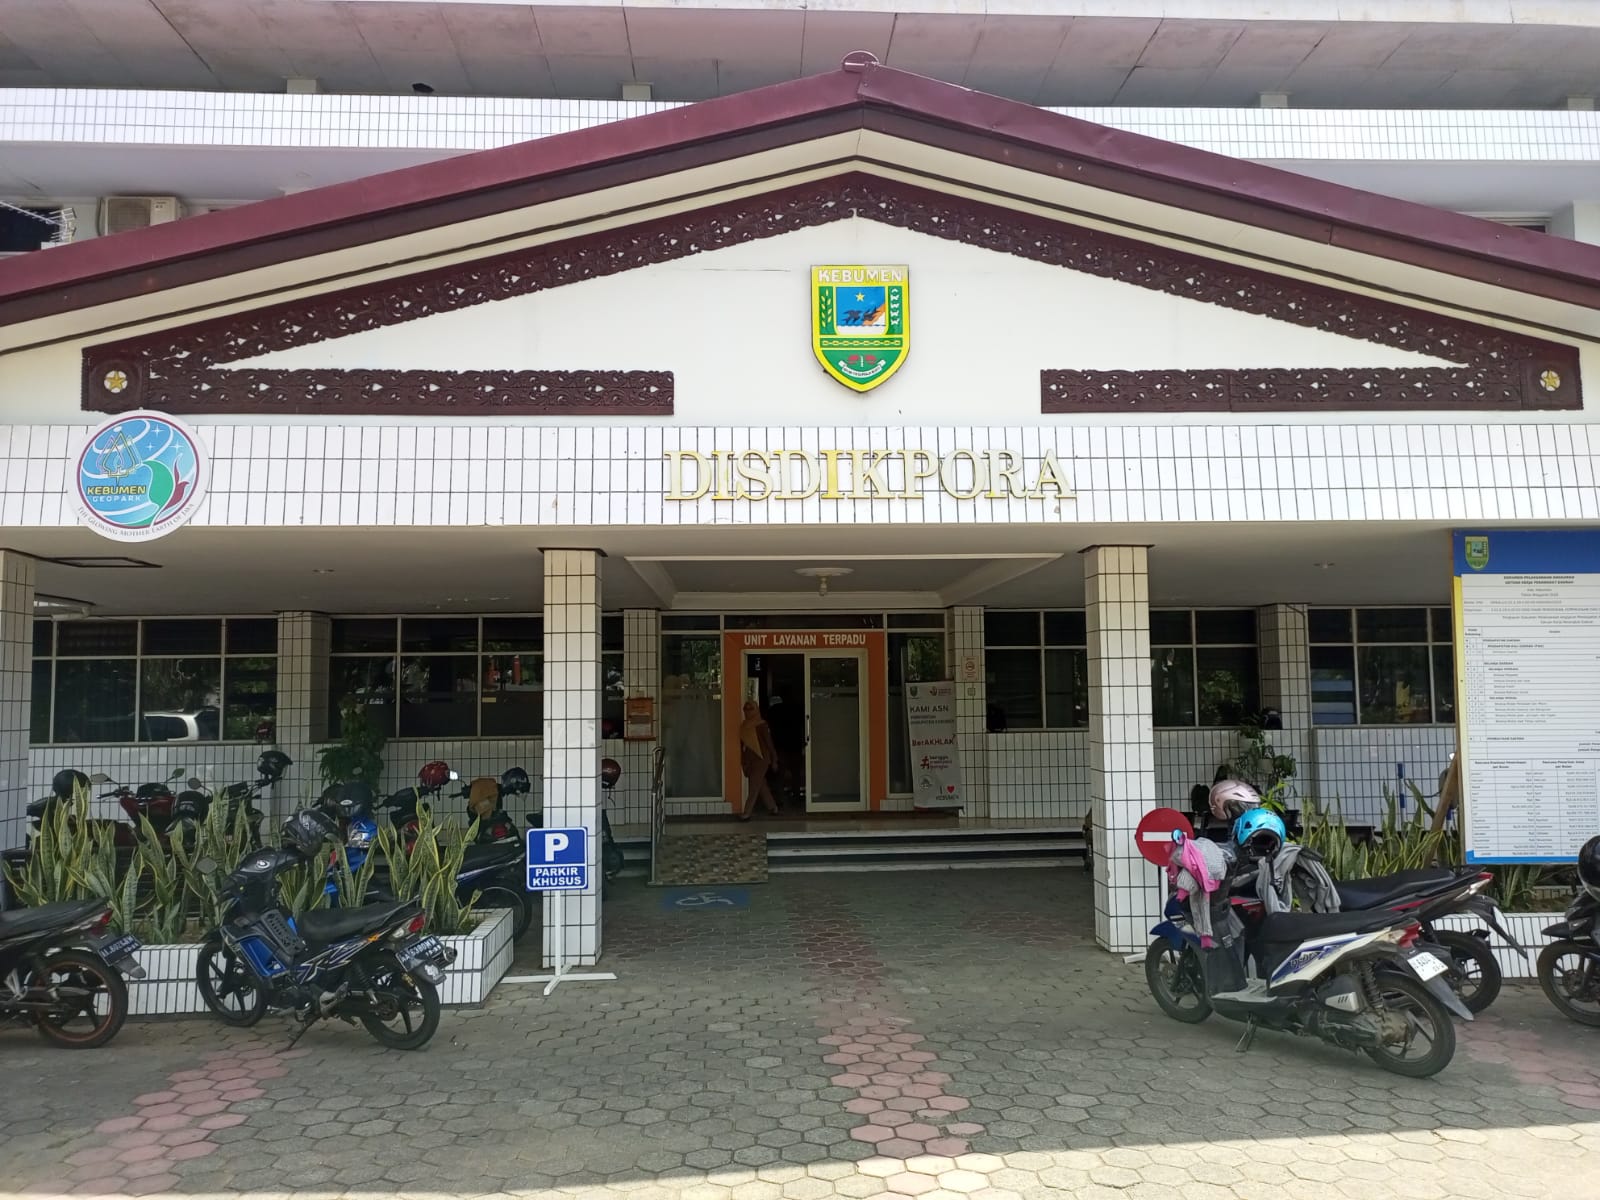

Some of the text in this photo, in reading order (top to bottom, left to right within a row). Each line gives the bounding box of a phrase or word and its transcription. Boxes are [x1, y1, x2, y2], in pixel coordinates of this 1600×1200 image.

[818, 269, 902, 282] KEBUMEN
[663, 448, 1077, 501] DISDIKPORA
[87, 485, 146, 496] KEBUMEN
[88, 517, 118, 535] GLOWING
[120, 529, 150, 537] MOTHER
[151, 521, 174, 534] EARTH
[744, 634, 866, 646] UNIT LAYANAN TERPADU
[910, 705, 930, 713] KAMI
[544, 832, 569, 862] P
[535, 867, 578, 877] PARKIR
[532, 877, 582, 887] KHUSUS
